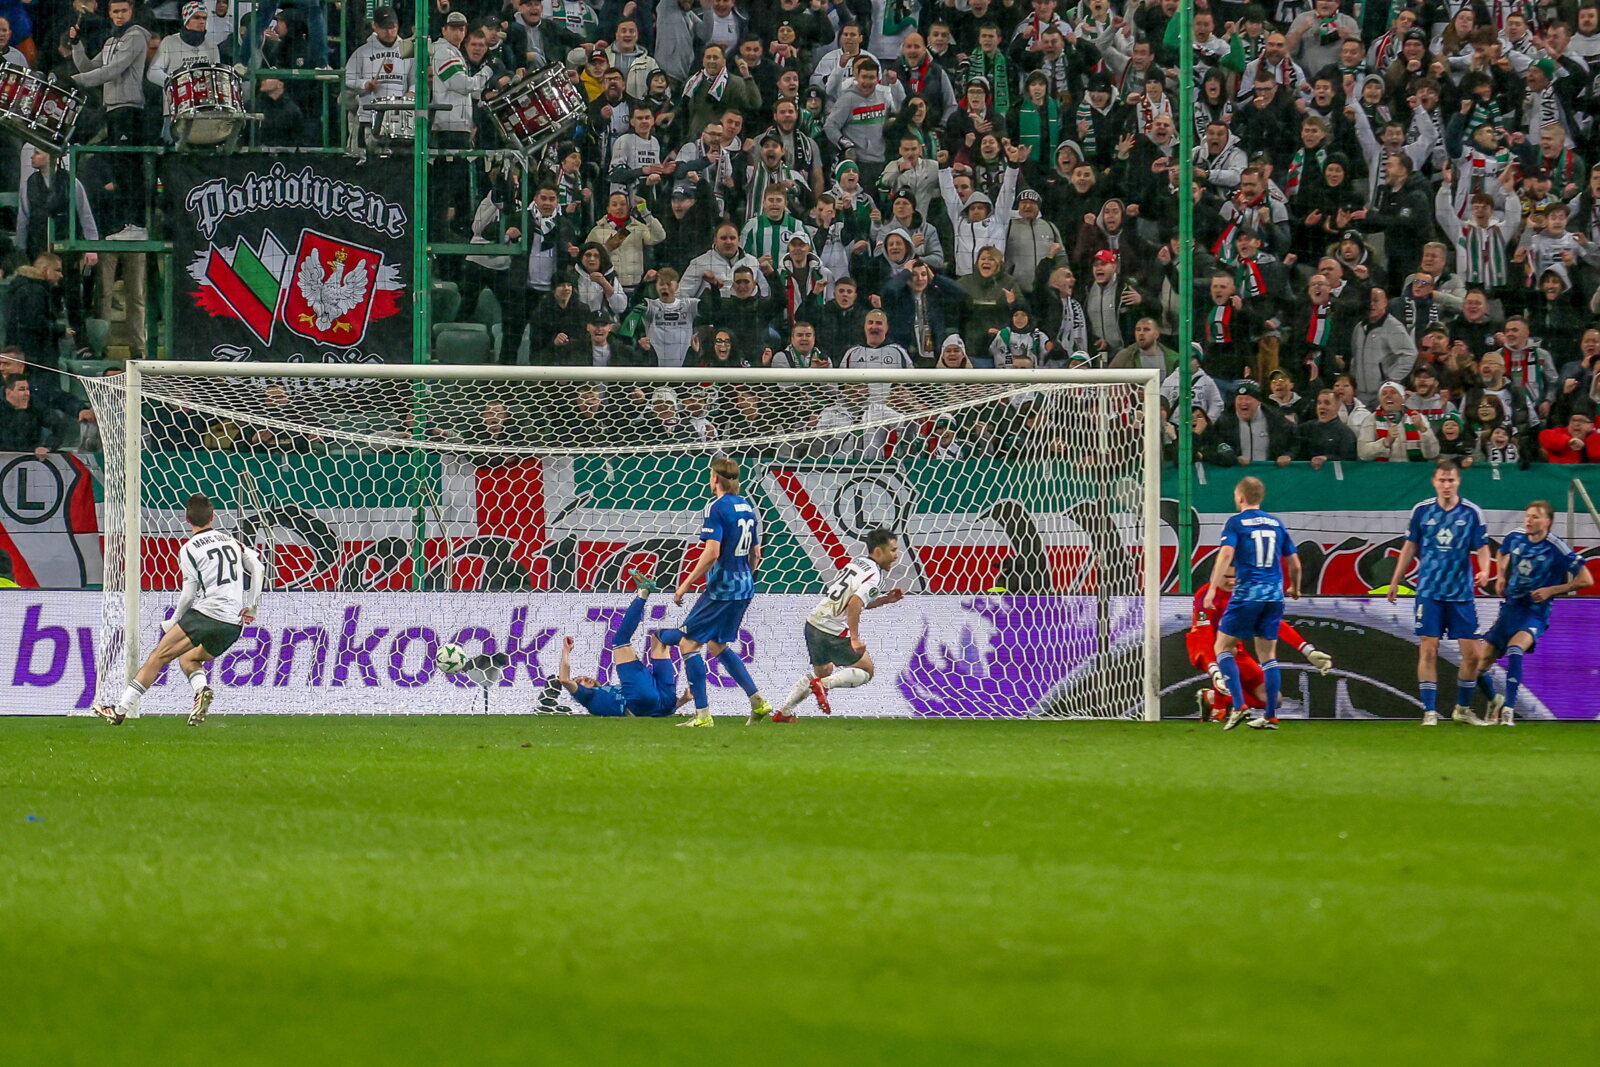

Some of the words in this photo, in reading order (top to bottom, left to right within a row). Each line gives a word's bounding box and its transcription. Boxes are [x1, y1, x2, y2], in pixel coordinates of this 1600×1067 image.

[369, 51, 404, 61] MOKOTÓ
[186, 162, 408, 240] Patriotyczne
[17, 468, 45, 510] L
[193, 536, 215, 548] MARC
[735, 518, 754, 556] 26
[1251, 530, 1276, 567] 17
[207, 545, 237, 586] 28
